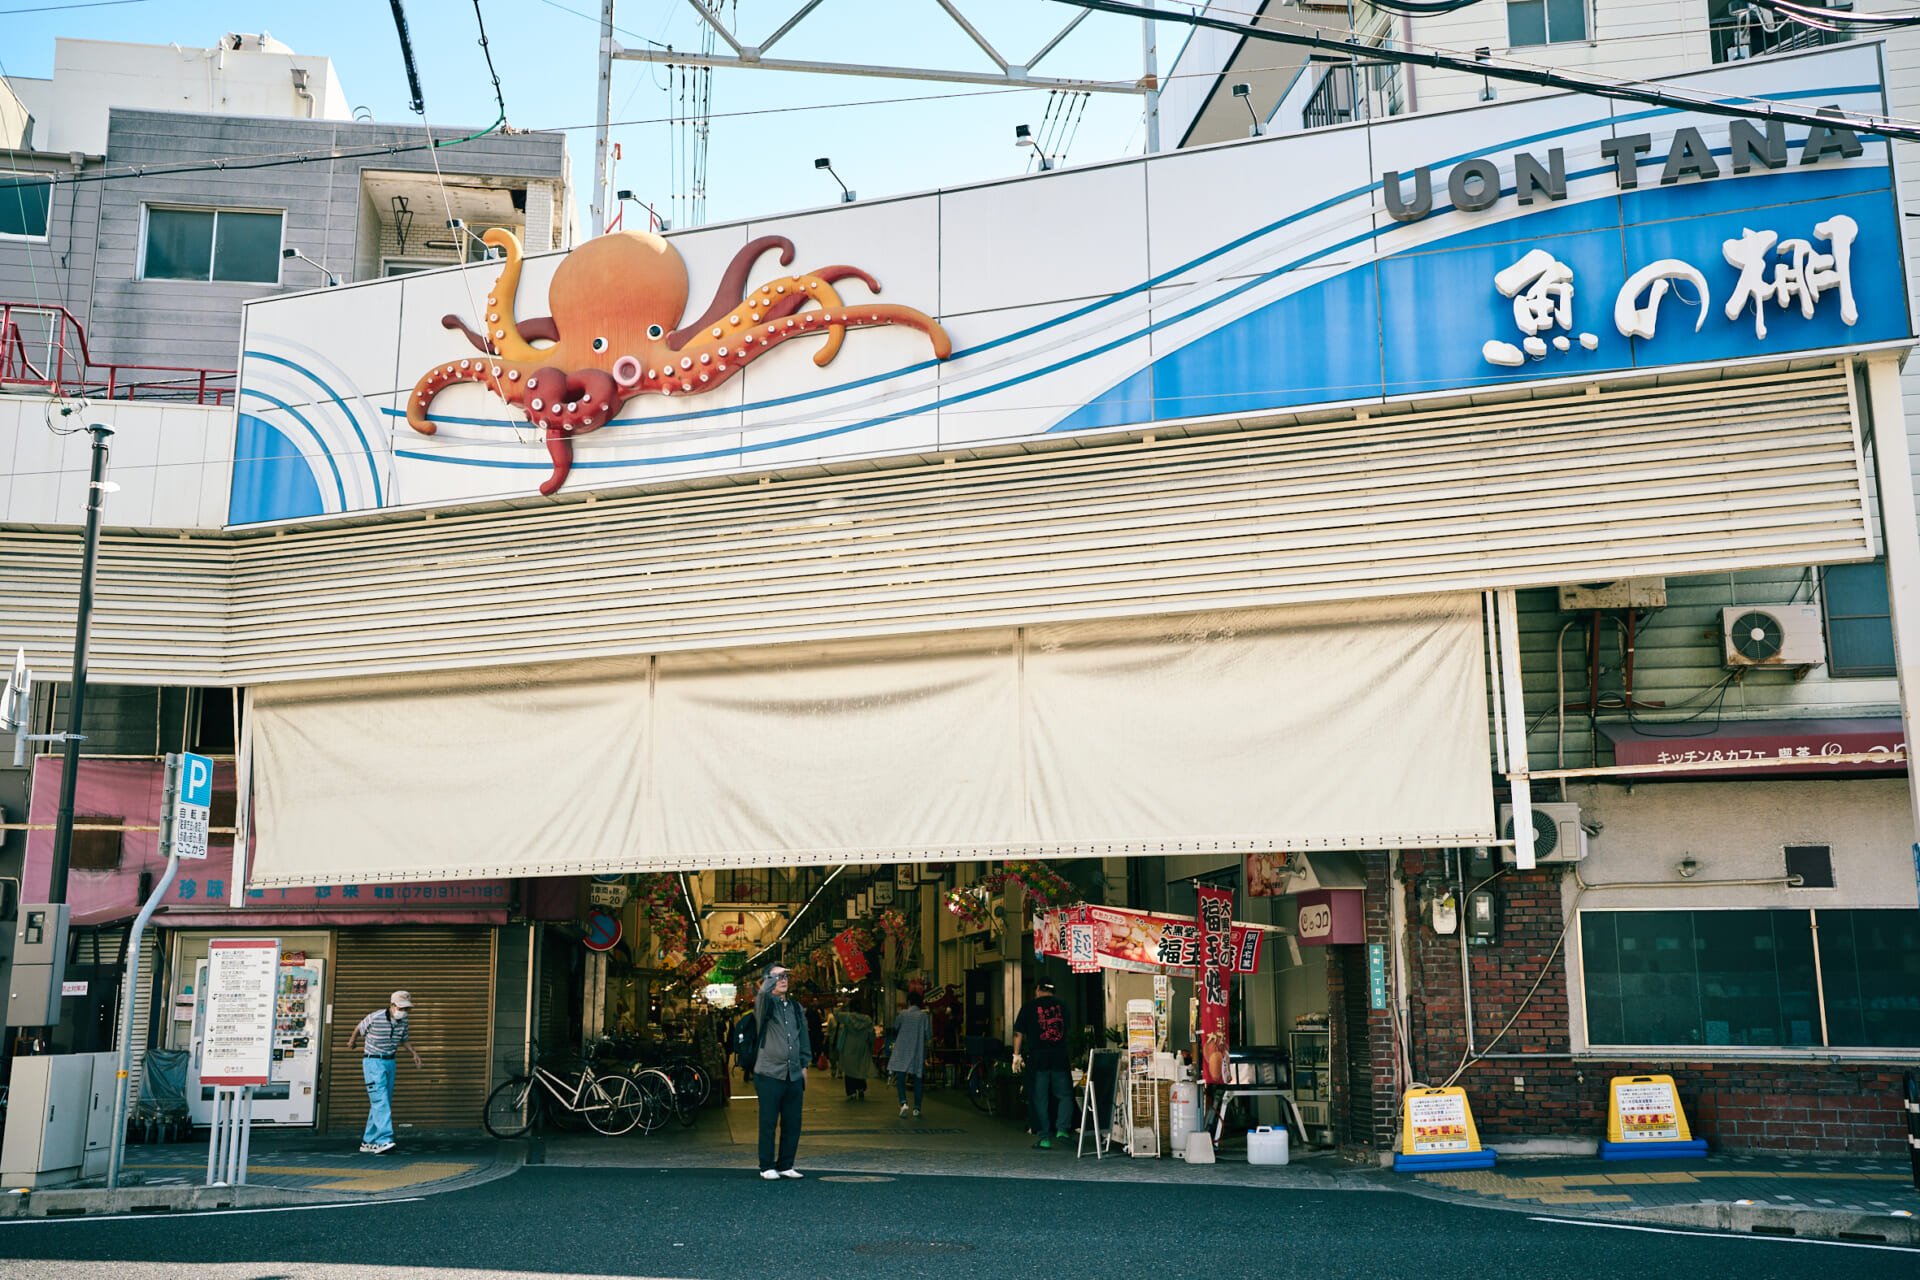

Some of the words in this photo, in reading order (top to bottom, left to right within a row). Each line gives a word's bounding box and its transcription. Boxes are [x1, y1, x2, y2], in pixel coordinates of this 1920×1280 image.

[1383, 148, 1567, 221] UON
[1600, 104, 1864, 190] TANA
[1482, 214, 1860, 367] 魚の棚
[1657, 750, 1766, 765] キッチン&カフェ
[188, 759, 207, 799] P
[178, 878, 224, 899] 珍味
